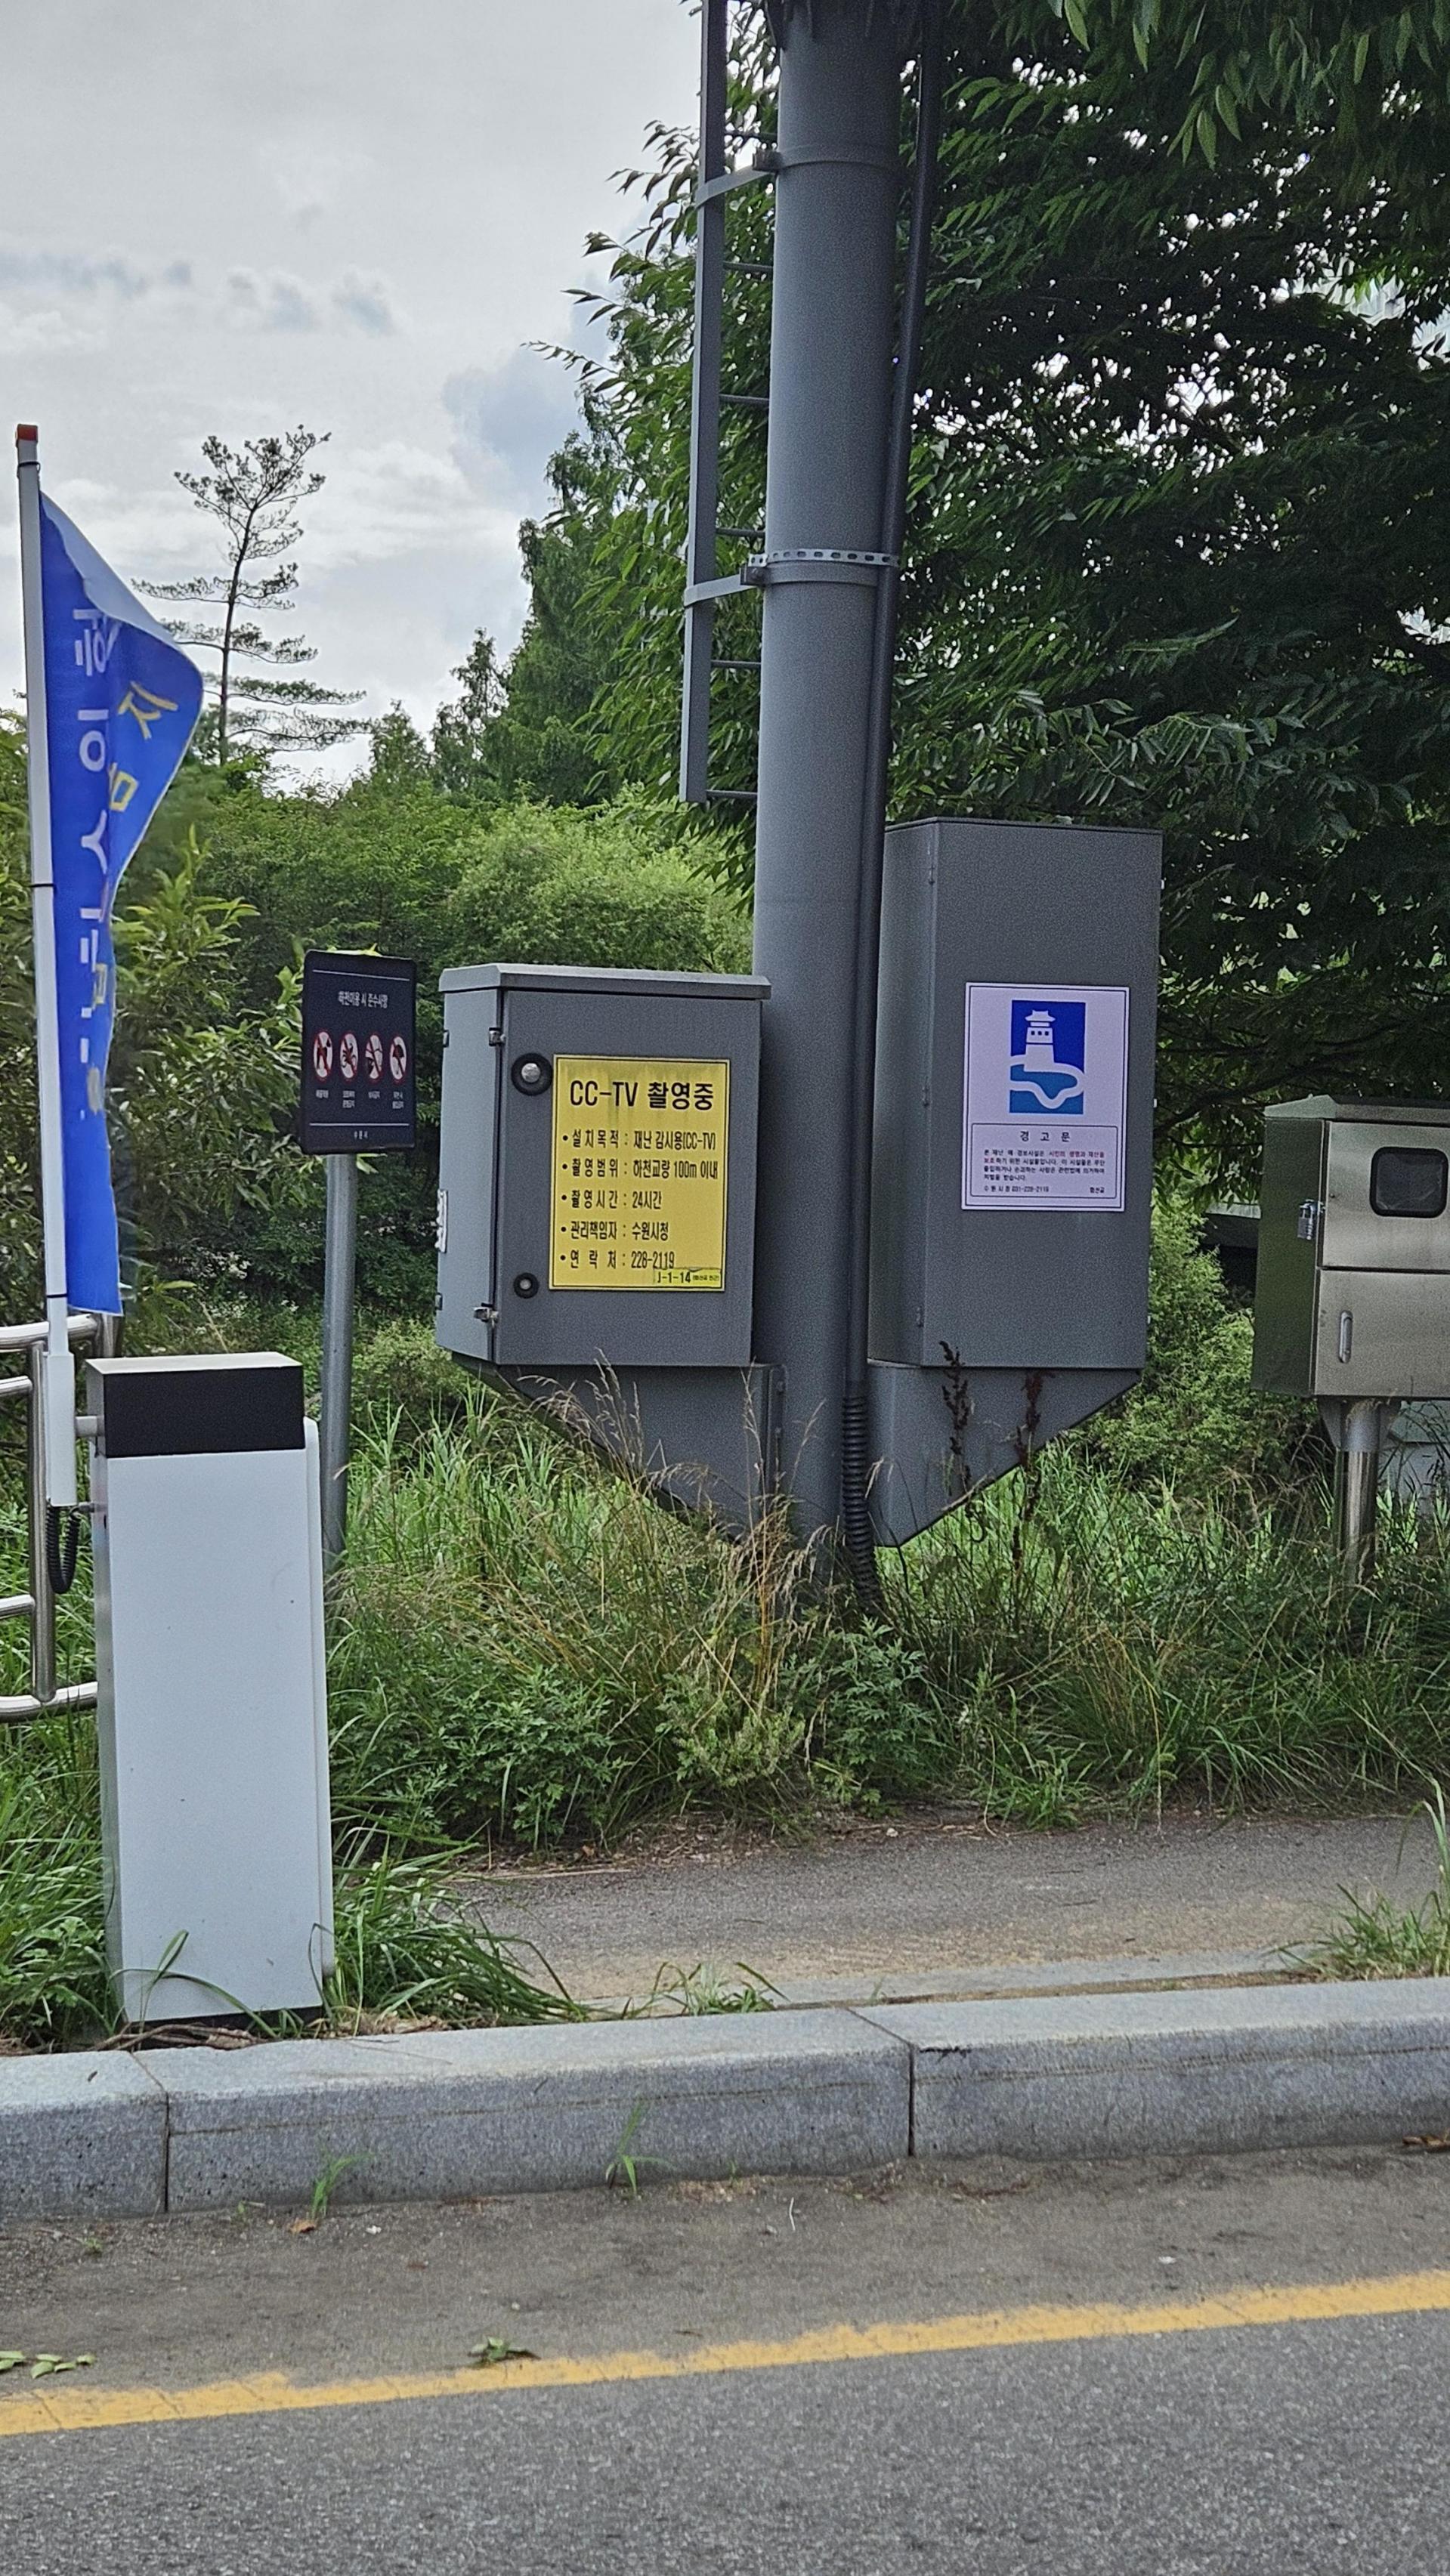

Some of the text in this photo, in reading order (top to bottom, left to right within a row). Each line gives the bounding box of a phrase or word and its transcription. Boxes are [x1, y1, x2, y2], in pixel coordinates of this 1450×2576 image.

[570, 1080, 714, 1110] CC-TV 촬영중
[572, 1129, 619, 1149] 설치목적
[633, 1131, 653, 1150] 재난
[572, 1158, 719, 1180] 촬영범위 하천교량 100m 이내
[570, 1189, 663, 1210] 촬영시간 24시간
[570, 1221, 669, 1241] 관리책임자 수원시청
[657, 1271, 691, 1284] J-1-14
